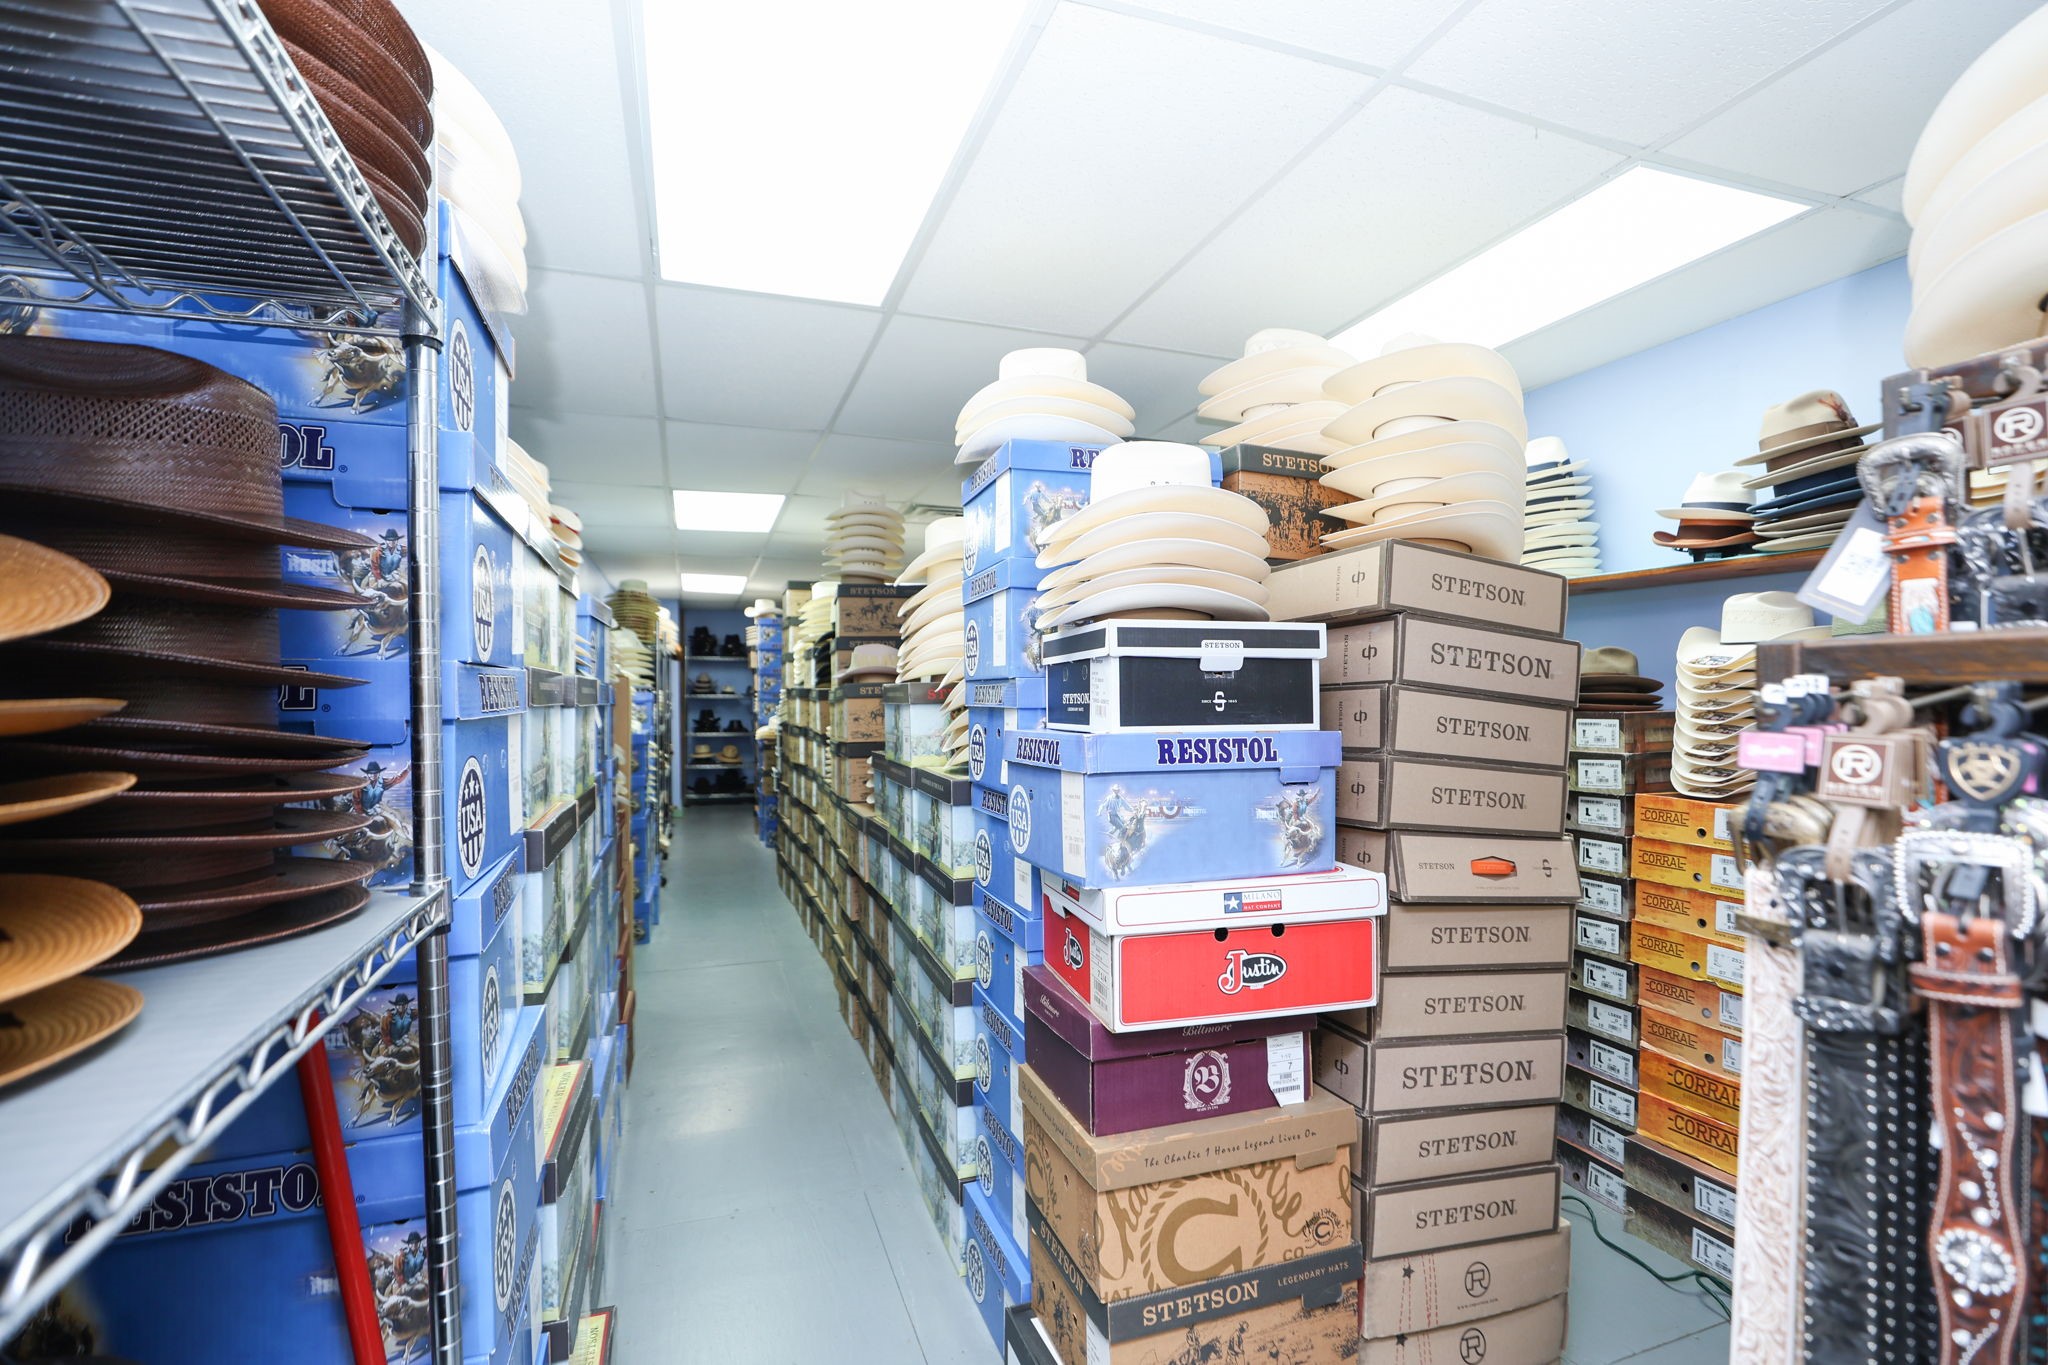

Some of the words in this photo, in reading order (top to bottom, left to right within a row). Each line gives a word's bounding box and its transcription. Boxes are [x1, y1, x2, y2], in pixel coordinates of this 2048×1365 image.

[970, 570, 996, 597] RESISTOL
[1431, 573, 1525, 606] STETSON
[1430, 642, 1552, 679] STETSON
[975, 685, 1003, 704] RESISTOL
[1062, 693, 1090, 704] STETSON
[1436, 716, 1530, 741] STETSON
[971, 743, 984, 760] USA
[1016, 737, 1061, 767] RESISTOL
[1156, 737, 1279, 765] RESISTOL
[1431, 786, 1525, 809] STETSON
[461, 801, 482, 838] USA
[1011, 808, 1028, 832] USA
[1644, 809, 1687, 825] CORRAL
[977, 848, 989, 868] USA
[1418, 862, 1455, 870] STETSON
[1642, 852, 1684, 869] CORRAL
[1243, 891, 1281, 901] MILANO
[1646, 895, 1688, 913] CORRAL
[983, 895, 1014, 934] RESISTOL
[1431, 926, 1530, 944] STETSON
[1641, 936, 1682, 957] CORRAL
[1218, 950, 1281, 994] Justin
[1424, 995, 1525, 1015] STETSON
[1649, 981, 1692, 1003] CORRAL
[983, 1000, 1012, 1050] RESISTOL
[1182, 1023, 1232, 1037] Biltmore
[1651, 1024, 1695, 1047] CORRAL
[1288, 1061, 1293, 1071] 7
[1402, 1060, 1533, 1089] STETSON
[1673, 1069, 1740, 1109] CORRAL
[984, 1104, 1015, 1164] RESISTOL
[1418, 1130, 1517, 1158] STETSON
[1144, 1156, 1160, 1168] The
[1163, 1150, 1201, 1165] Charlie
[1205, 1147, 1211, 1158] 1
[1215, 1143, 1241, 1156] Horse
[1244, 1136, 1276, 1152] Legend
[1278, 1133, 1302, 1145] Lives
[1304, 1128, 1317, 1138] On
[1415, 1199, 1516, 1230] STETSON
[974, 1209, 1007, 1280] RESISTOL
[1157, 1193, 1242, 1287] C
[1040, 1219, 1085, 1297] STETSON
[1277, 1267, 1326, 1287] LEGENDARY
[1328, 1260, 1349, 1274] HATS
[1142, 1279, 1260, 1327] STETSON
